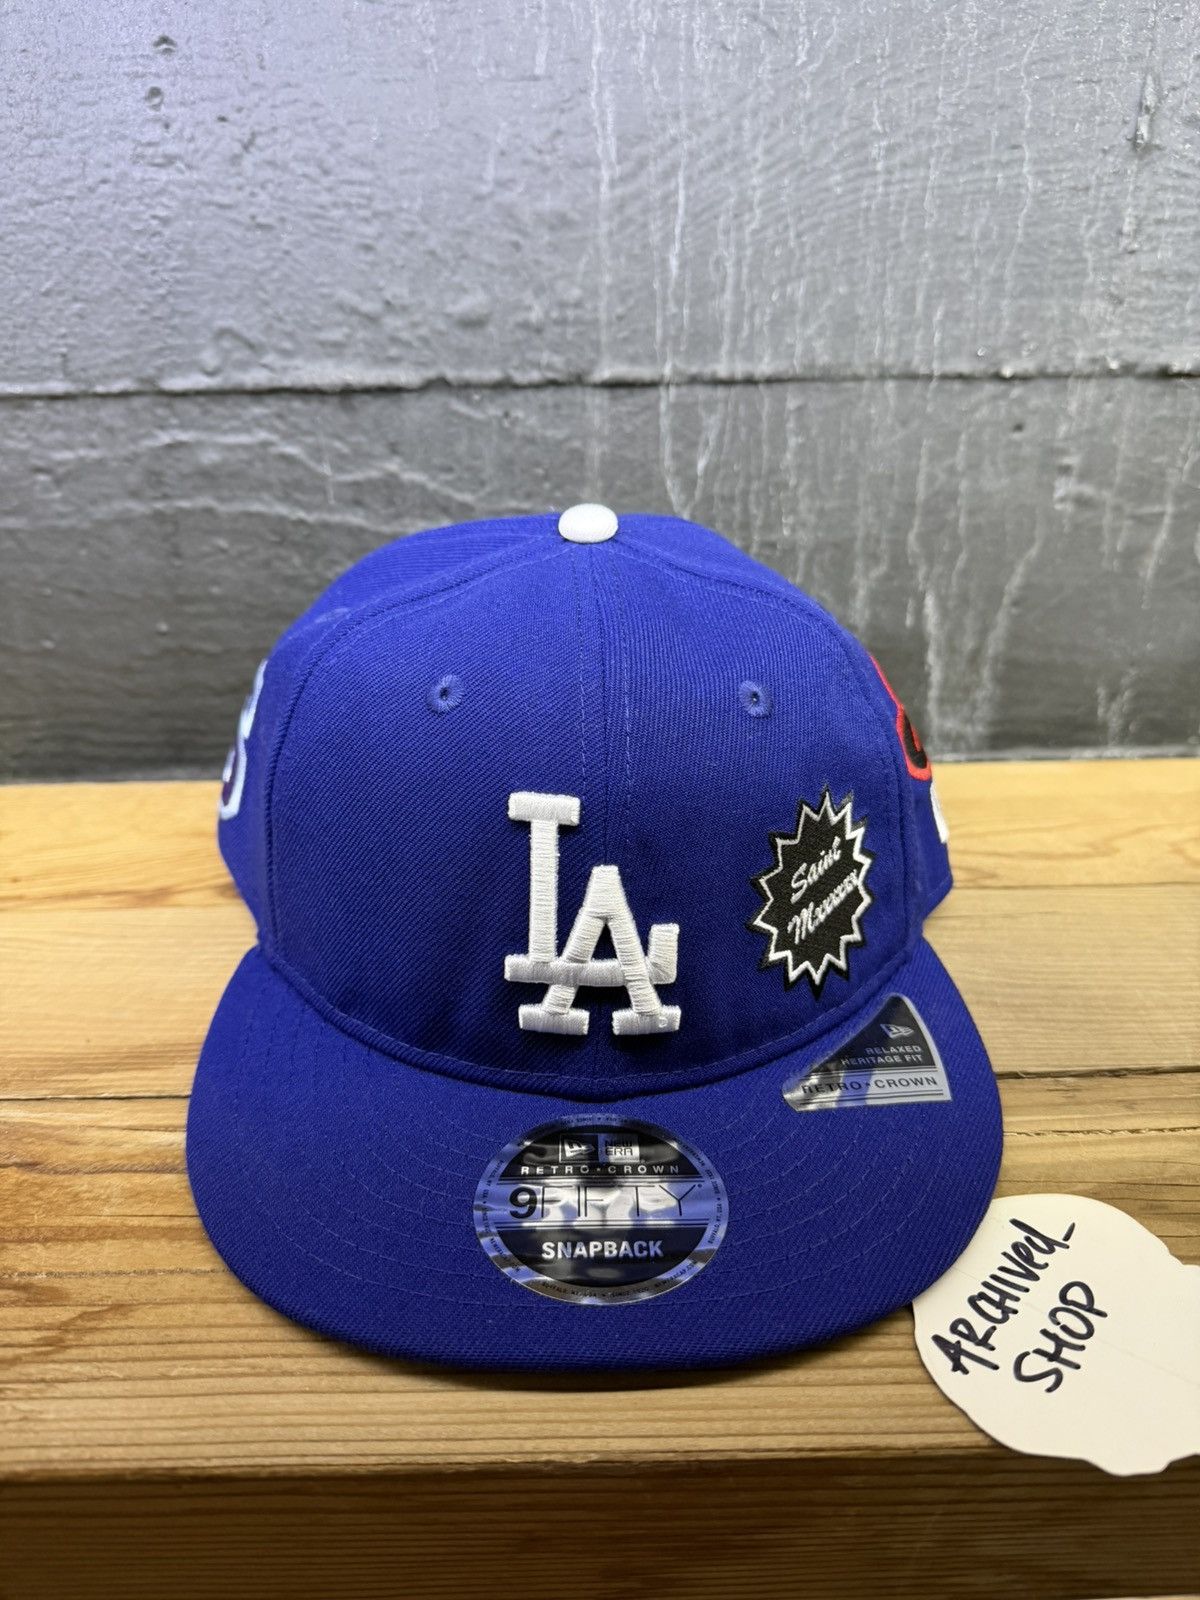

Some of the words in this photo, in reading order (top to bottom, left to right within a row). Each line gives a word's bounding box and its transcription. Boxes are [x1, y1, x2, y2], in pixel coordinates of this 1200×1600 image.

[790, 836, 841, 904] Saint
[504, 791, 682, 1036] LA
[865, 1046, 922, 1056] RELAXED
[840, 1056, 903, 1067] HERITAGE
[905, 1054, 923, 1063] FIT
[874, 1076, 938, 1089] CROWN
[604, 1147, 634, 1156] ERA
[520, 1165, 590, 1175] RETRO
[608, 1165, 680, 1175] CROWN
[541, 1240, 665, 1259] SNAPBACK
[1013, 1280, 1108, 1393] SHOP
